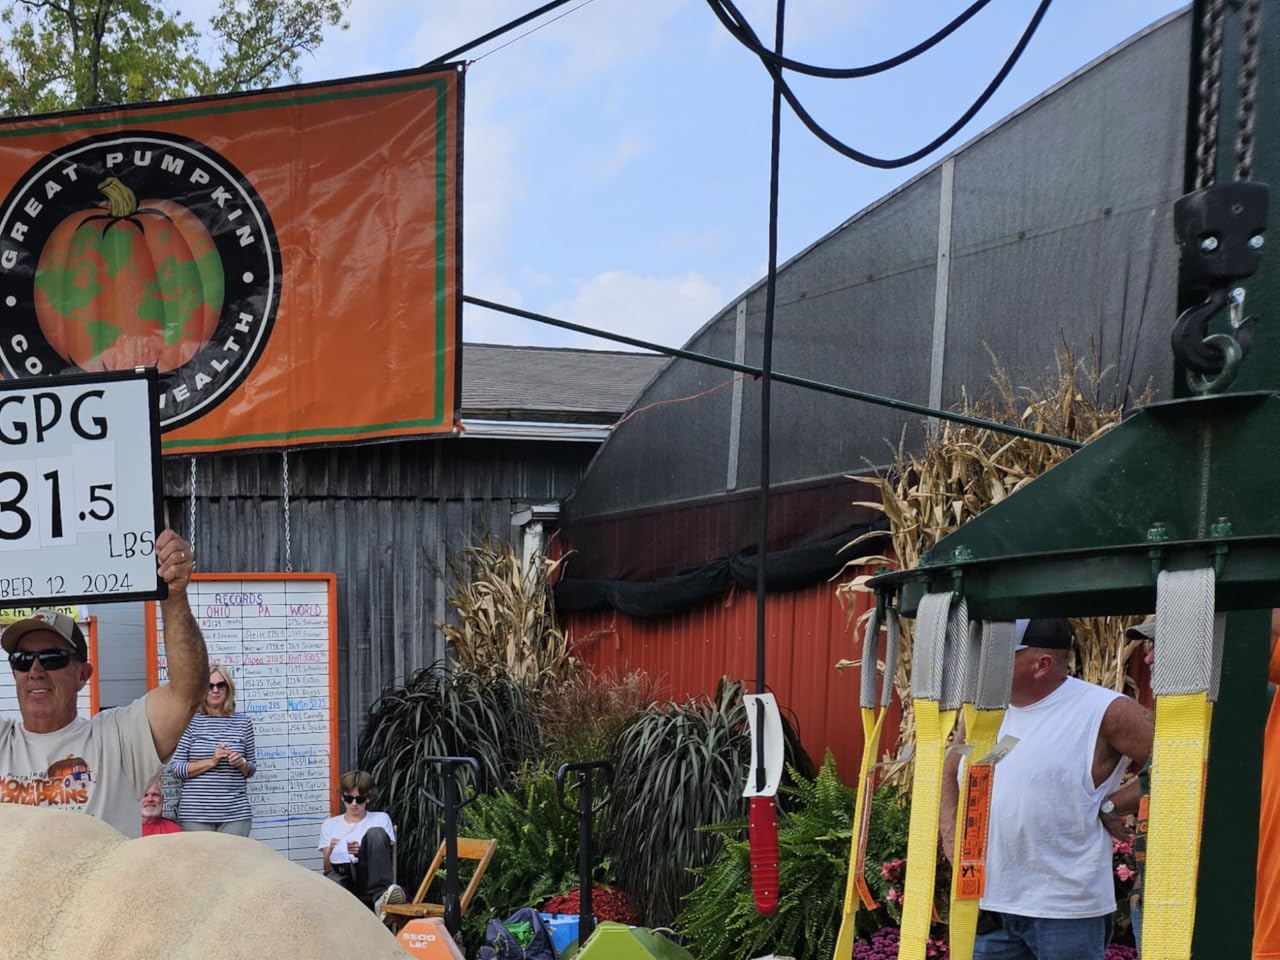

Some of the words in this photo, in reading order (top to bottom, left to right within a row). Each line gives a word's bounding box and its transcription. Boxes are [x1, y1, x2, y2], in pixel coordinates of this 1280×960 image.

[1, 163, 79, 270] GREAT
[105, 150, 256, 248] PUMPKIN
[11, 312, 254, 409] COEALTH
[108, 530, 154, 558] LBS
[46, 575, 66, 595] 12
[82, 572, 134, 593] 2024
[207, 605, 230, 618] OHIO
[258, 605, 272, 617] PA
[289, 604, 322, 617] WORLD
[214, 593, 263, 605] RECORDS
